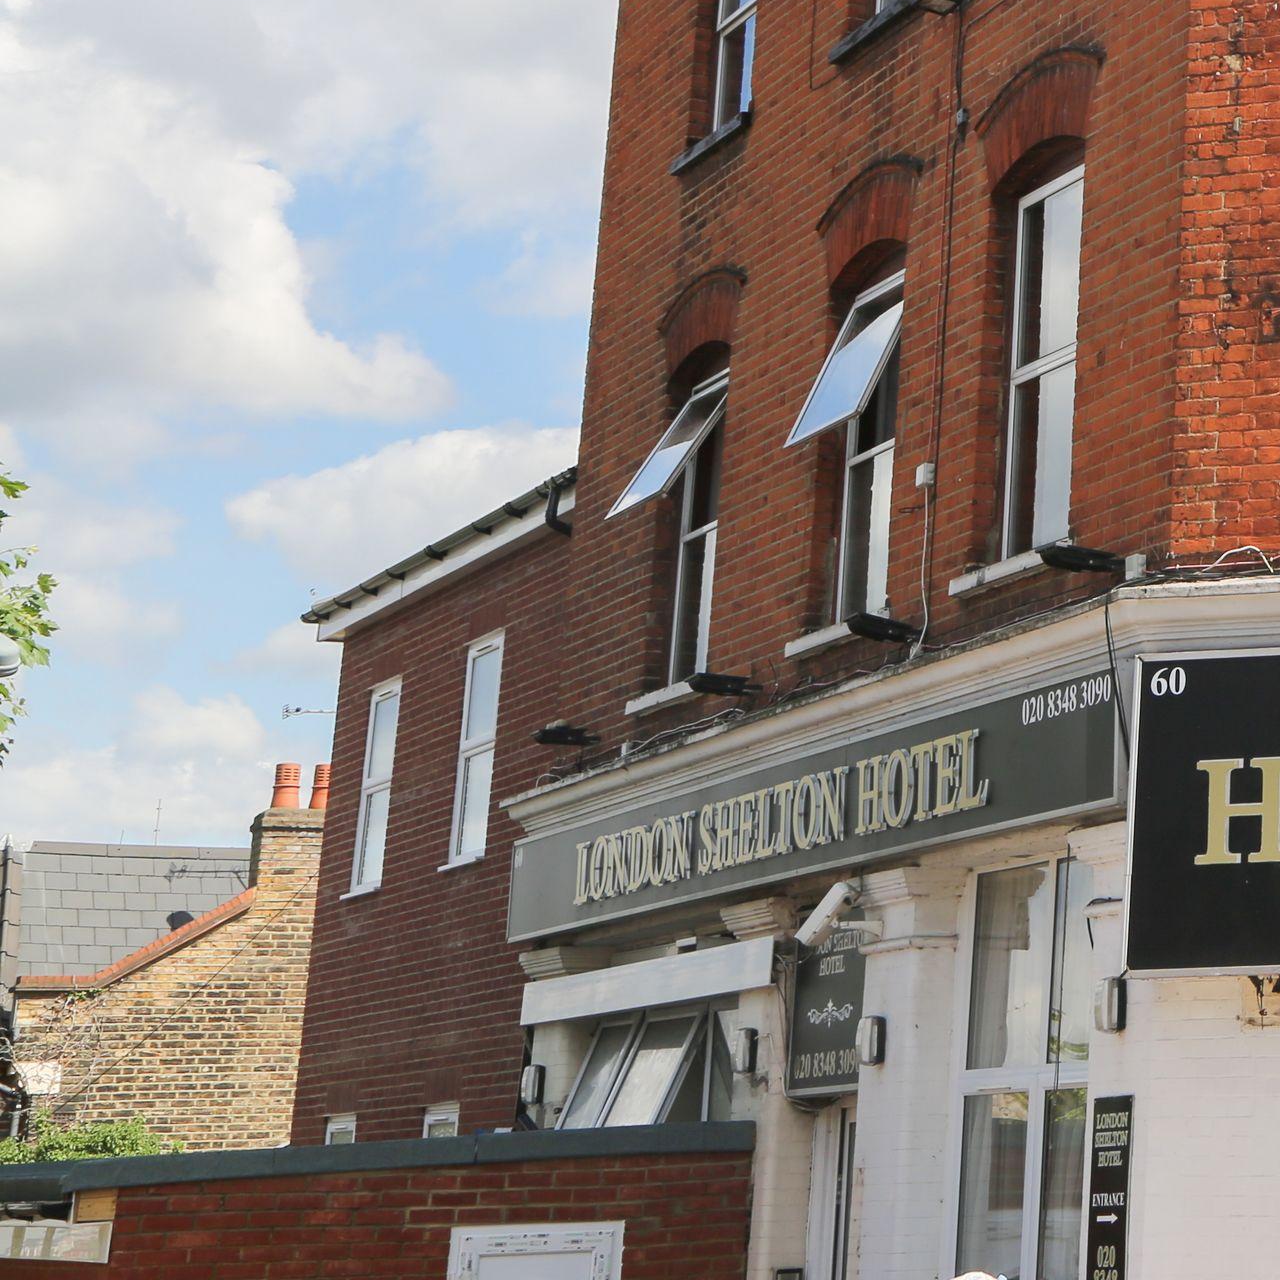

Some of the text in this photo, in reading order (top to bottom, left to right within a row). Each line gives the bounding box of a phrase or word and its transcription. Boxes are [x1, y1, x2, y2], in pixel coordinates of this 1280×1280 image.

[1150, 666, 1187, 697] 60
[1021, 674, 1112, 726] 020 8348 3090
[573, 727, 990, 906] LONDON SHELTON HOTEL
[818, 954, 846, 977] HOTEL
[812, 1050, 837, 1078] 8348
[1096, 1111, 1129, 1130] LONDON
[1094, 1130, 1129, 1148] SHELTON
[1097, 1150, 1123, 1167] HOTEL
[1092, 1192, 1125, 1207] ENTRANCE
[1097, 1245, 1116, 1268] 020
